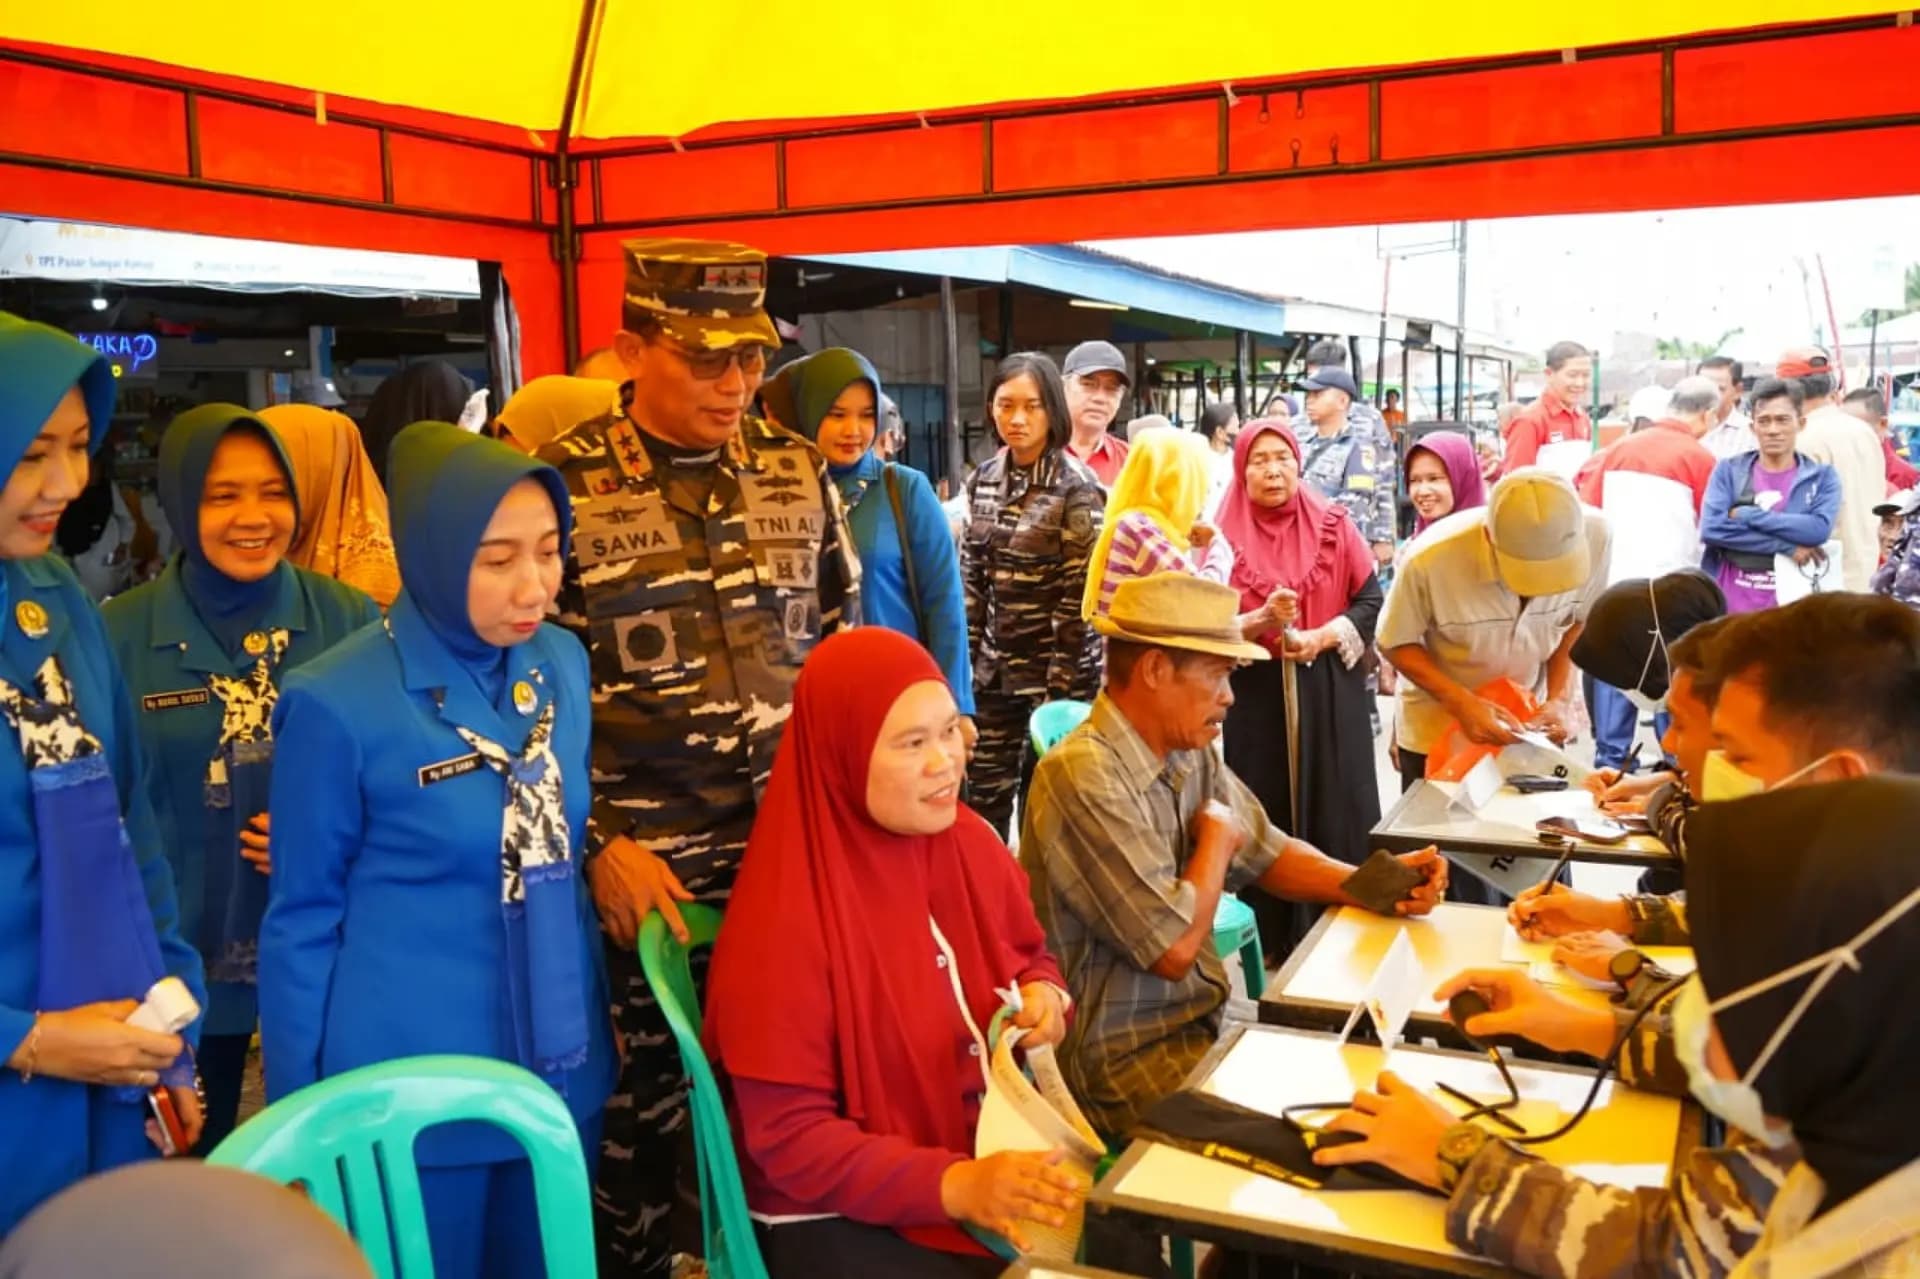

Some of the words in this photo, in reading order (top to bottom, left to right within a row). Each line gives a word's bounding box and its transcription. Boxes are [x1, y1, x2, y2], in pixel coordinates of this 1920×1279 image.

[754, 517, 791, 534] TNI
[797, 517, 818, 535] AL
[592, 529, 667, 557] SAWA
